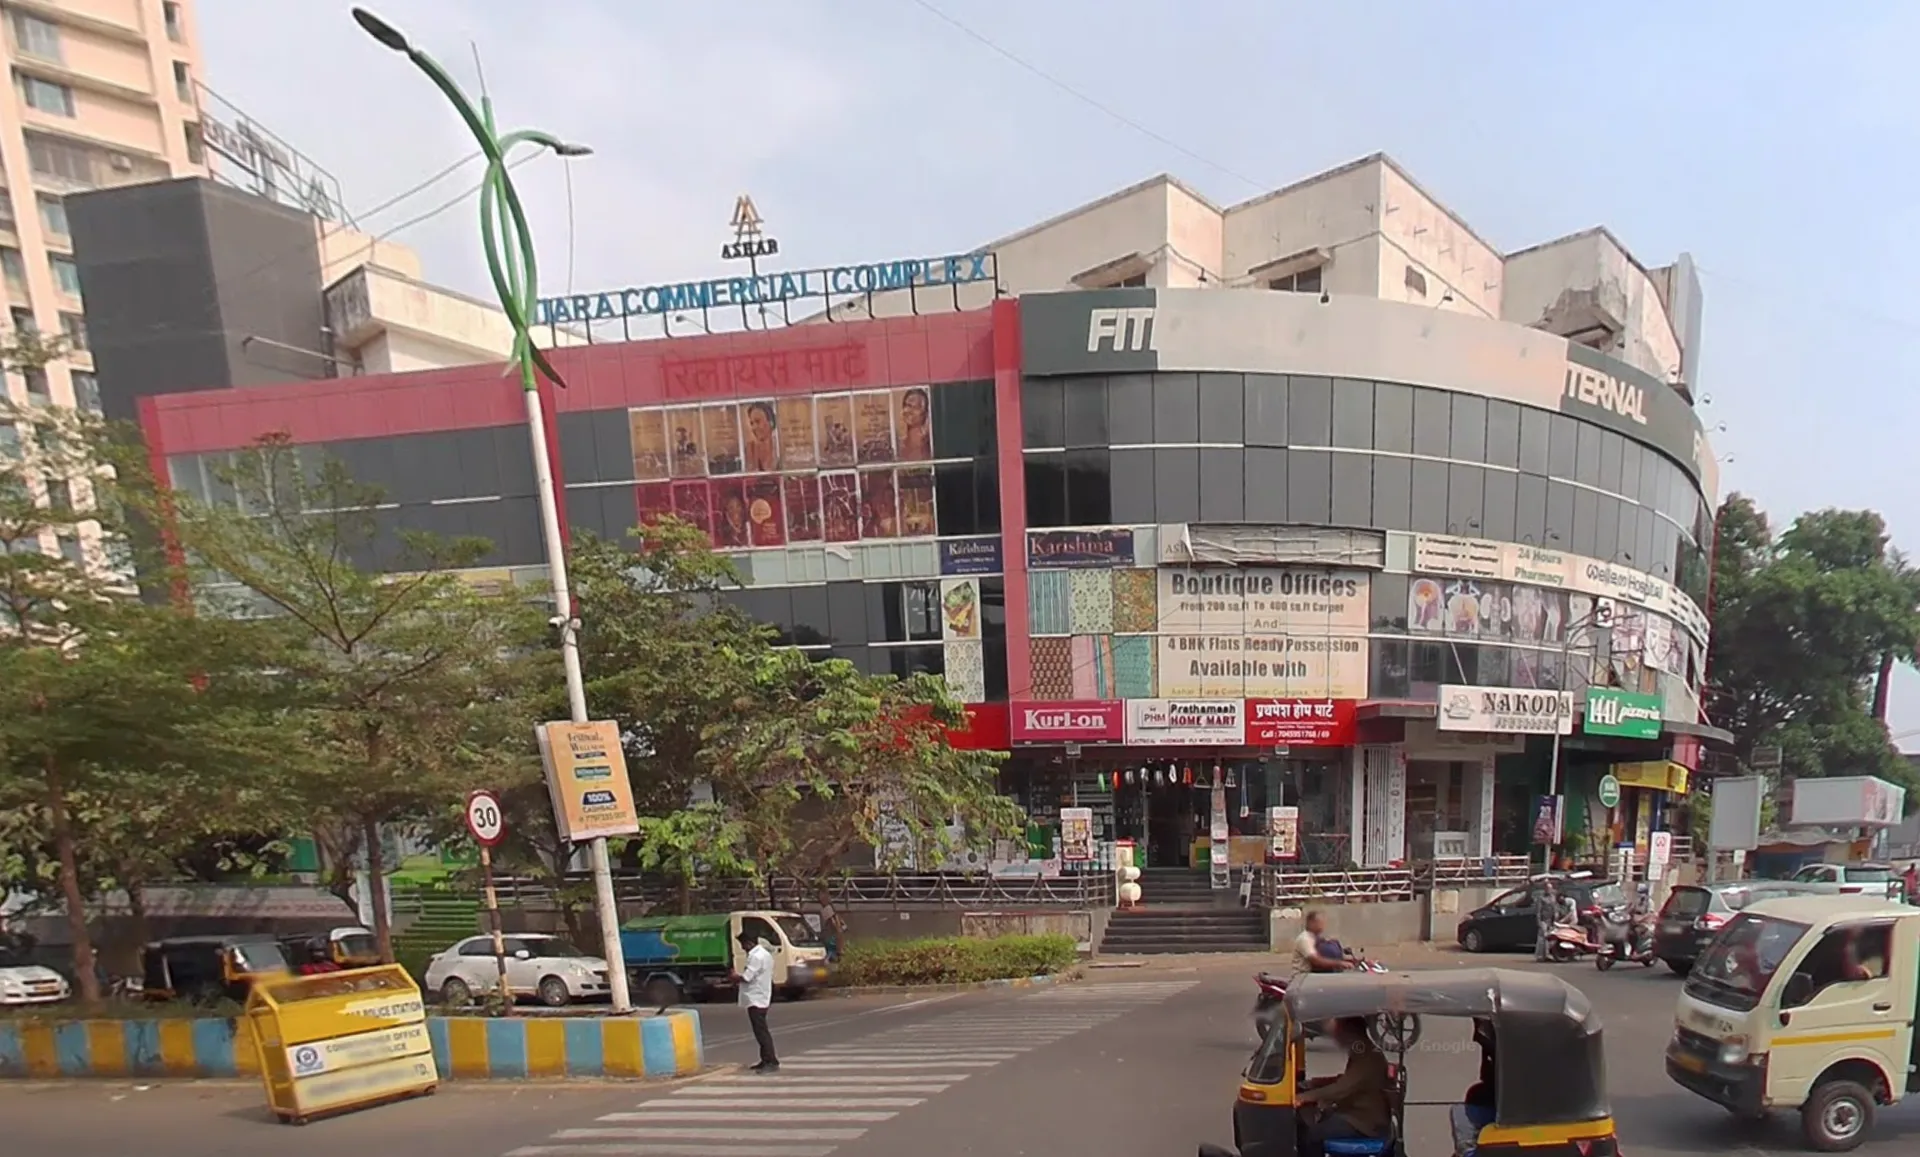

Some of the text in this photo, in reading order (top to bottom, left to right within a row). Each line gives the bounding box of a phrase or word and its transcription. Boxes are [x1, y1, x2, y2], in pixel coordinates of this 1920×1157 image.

[721, 238, 779, 259] ASHAR
[622, 271, 819, 315] COMMERCIAL
[831, 251, 987, 293] COMPLEX
[1030, 534, 1114, 557] Karishma
[1517, 548, 1563, 565] 24 Hours
[1514, 566, 1565, 586] Pharmacy
[1172, 572, 1358, 598] Boutique Offices
[1207, 601, 1225, 611] 200
[1254, 601, 1265, 612] To
[1270, 601, 1287, 611] 400
[1312, 602, 1345, 614] Carpet
[1254, 618, 1278, 629] And
[1168, 637, 1359, 653] 4 BHK Flats Ready Possession
[1190, 660, 1268, 678] Available
[1272, 660, 1307, 677] with
[1481, 692, 1571, 716] NAKODA
[1024, 710, 1107, 731] Kurl-on
[1144, 713, 1166, 723] PHM
[1171, 716, 1236, 726] HOME MART
[1261, 730, 1274, 738] Call
[474, 806, 498, 828] 30
[363, 1005, 391, 1018] POLICE
[392, 1002, 422, 1017] STATION
[393, 1029, 422, 1040] OFFICE
